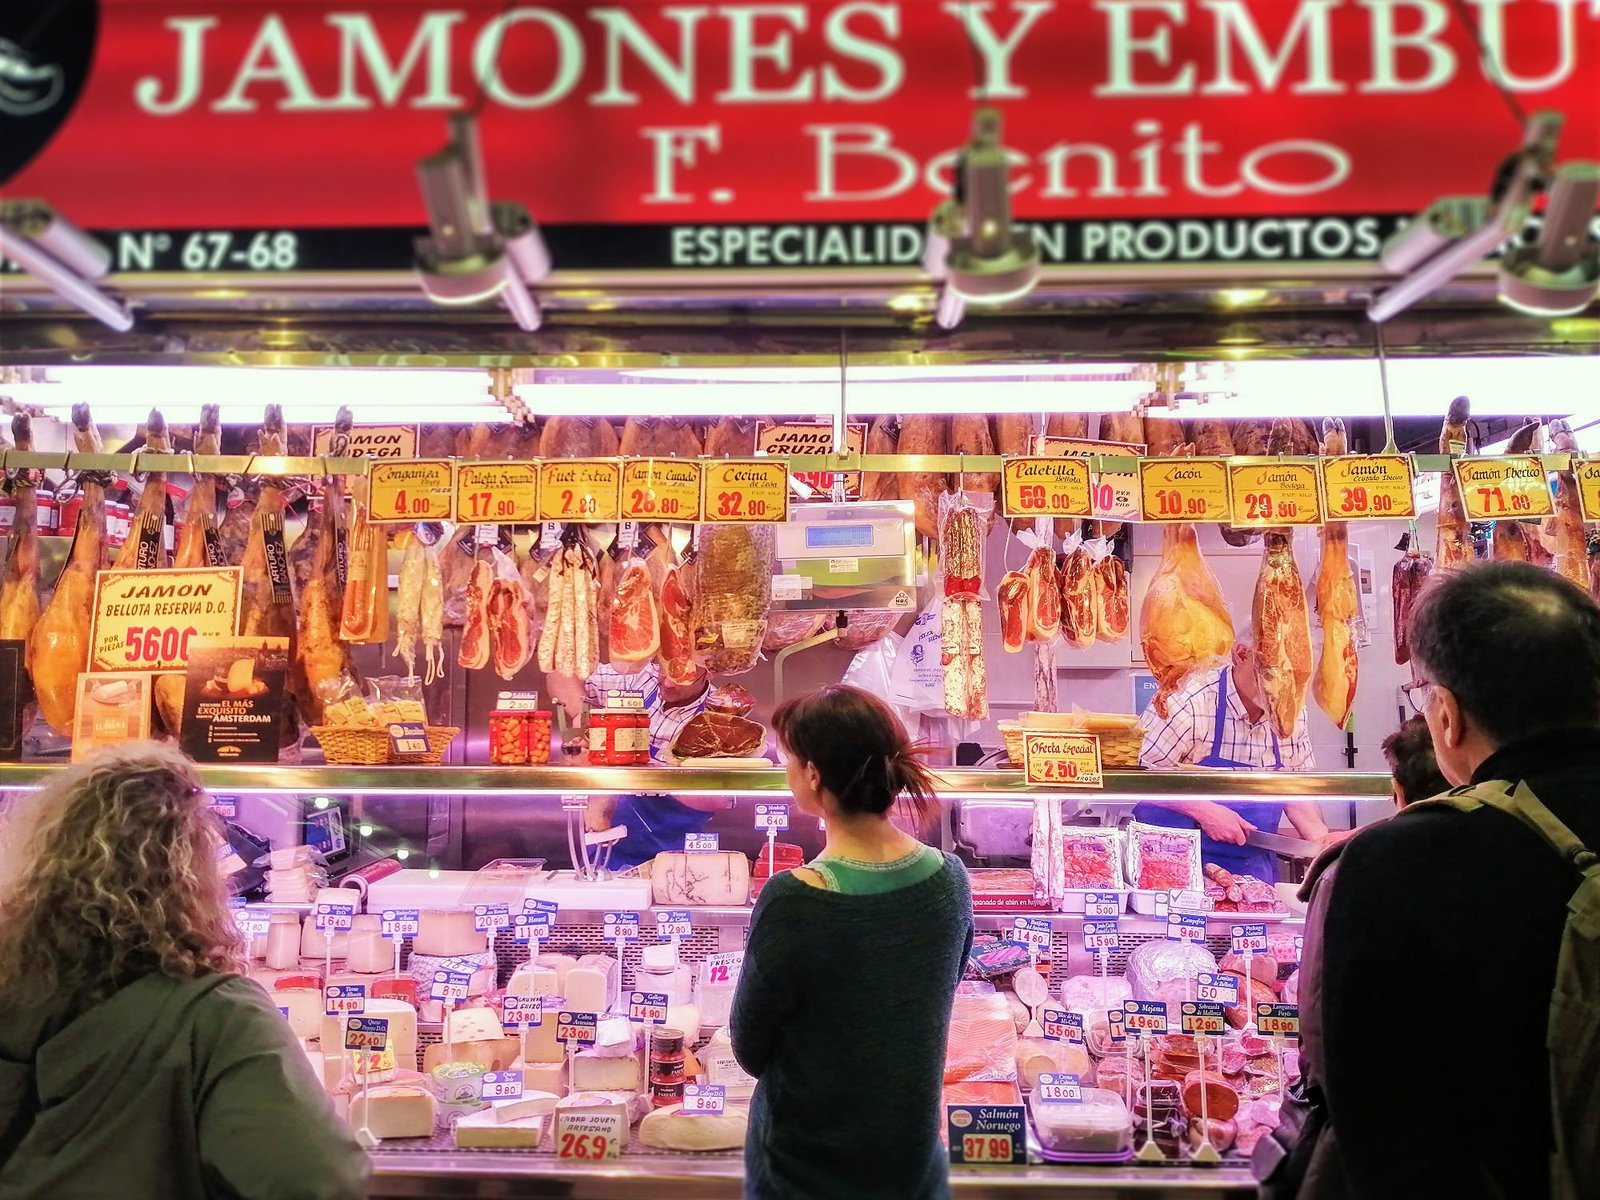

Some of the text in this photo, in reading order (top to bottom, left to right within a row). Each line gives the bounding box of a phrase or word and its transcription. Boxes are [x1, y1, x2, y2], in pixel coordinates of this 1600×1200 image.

[135, 0, 1600, 115] JAMONES Y EMBU
[640, 123, 735, 204] F.
[671, 225, 927, 266] ESPECIALID
[1083, 217, 1379, 262] PRODUCTOS
[181, 231, 299, 269] 67-68
[774, 432, 834, 444] JAMO
[547, 467, 577, 485] Fuet
[722, 467, 769, 483] Cecina
[1015, 462, 1076, 479] Paletilla
[1340, 460, 1388, 478] Jamón
[1462, 466, 1501, 483] Jamón
[1256, 470, 1298, 485] Jamón
[266, 544, 281, 583] ARTURO
[120, 583, 213, 599] JAMON
[105, 601, 227, 617] BELLOTA RESERVA D.O.
[99, 640, 125, 654] PIEZAS
[103, 634, 119, 645] POR
[197, 706, 247, 716] EXQUISITO
[221, 700, 231, 708] EL
[1030, 742, 1061, 756] Oferta
[1141, 1004, 1164, 1013] Mojama
[978, 1107, 1020, 1120] Salmón
[975, 1119, 1022, 1133] Noruego
